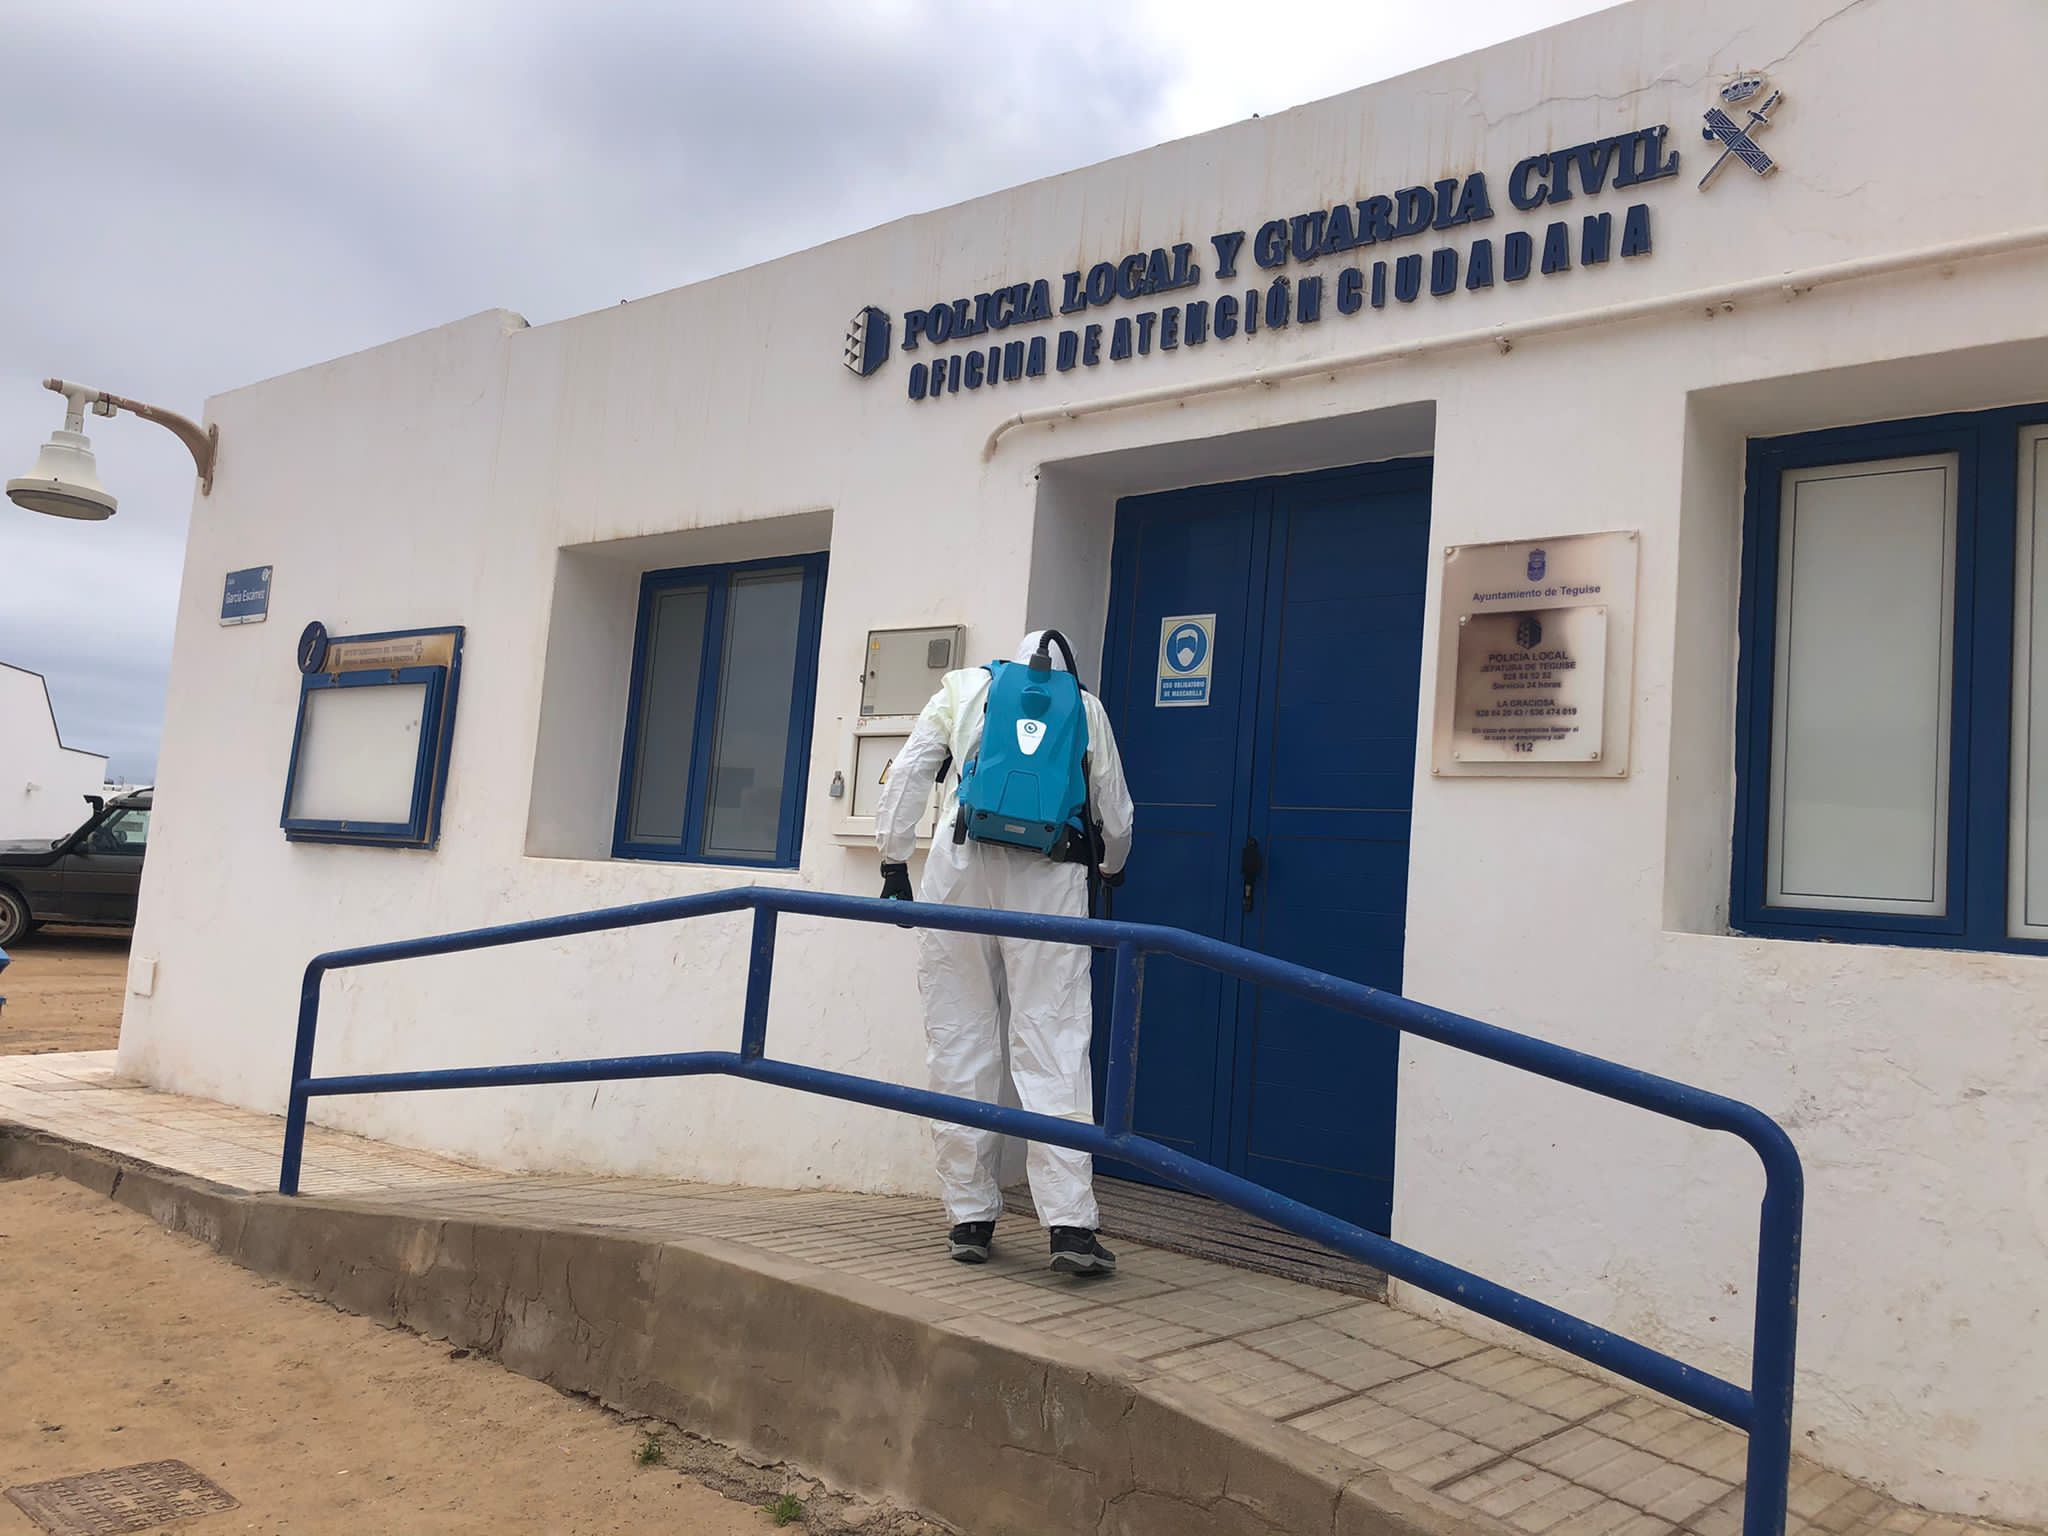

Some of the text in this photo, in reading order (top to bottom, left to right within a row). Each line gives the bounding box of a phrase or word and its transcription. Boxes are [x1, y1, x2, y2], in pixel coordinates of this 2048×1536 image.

[901, 124, 1681, 351] POLICIA LOCAL Y GUARDIA CIVIL
[908, 203, 1652, 401] OFICINA DE ATENCIÓN CIUDADANA
[1472, 584, 1601, 603] Ayuntamiento de Teguise
[1488, 650, 1569, 663] POLICIA LOCAL
[1510, 699, 1555, 708] GRACIOSA
[1515, 742, 1533, 753] 112
